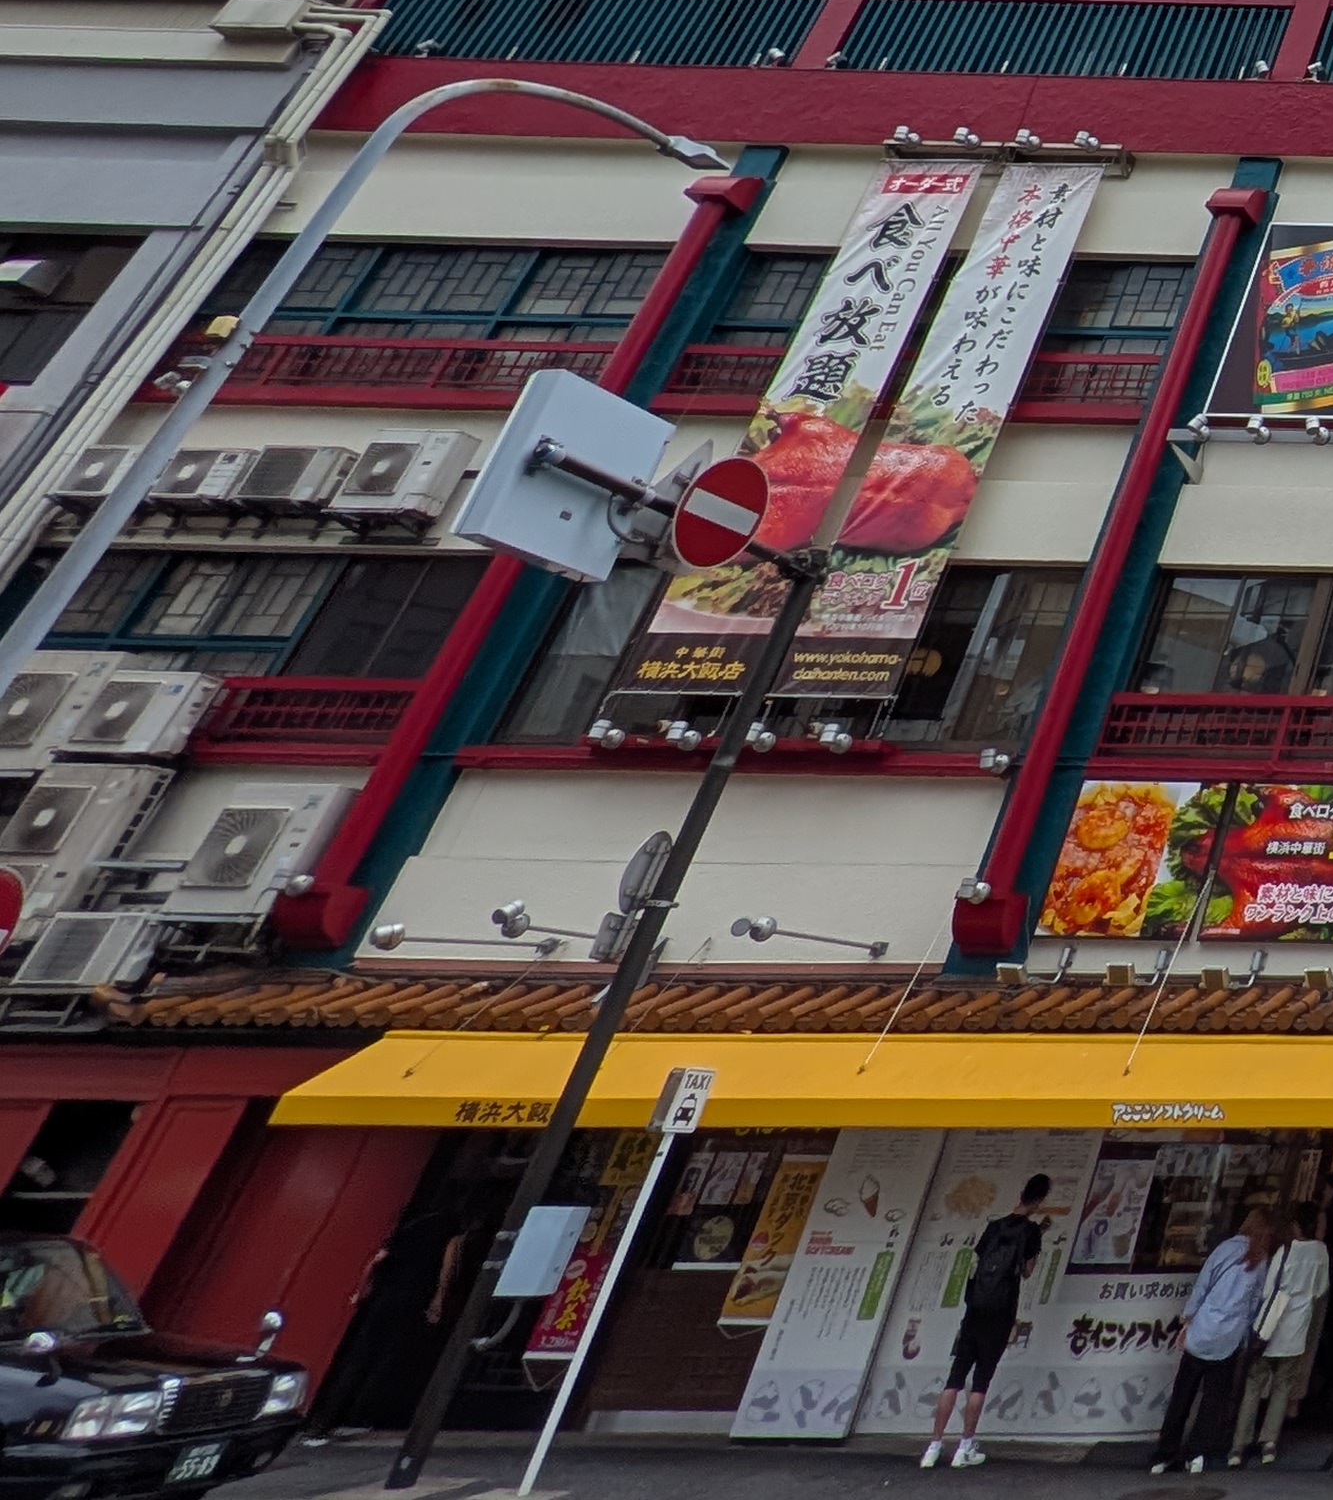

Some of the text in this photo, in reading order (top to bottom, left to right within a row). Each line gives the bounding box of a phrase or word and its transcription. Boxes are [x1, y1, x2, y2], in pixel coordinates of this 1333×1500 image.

[888, 176, 964, 193] オーダー式
[783, 201, 925, 403] 食べ放題
[870, 204, 949, 352] All You Can Eat
[932, 184, 1042, 407] 本格中華が味わえる
[955, 182, 1072, 422] 素材と味にこだわった
[1266, 841, 1327, 856] 横浜中華街
[455, 1101, 556, 1124] 横浜大飯
[684, 1073, 713, 1091] TAXI
